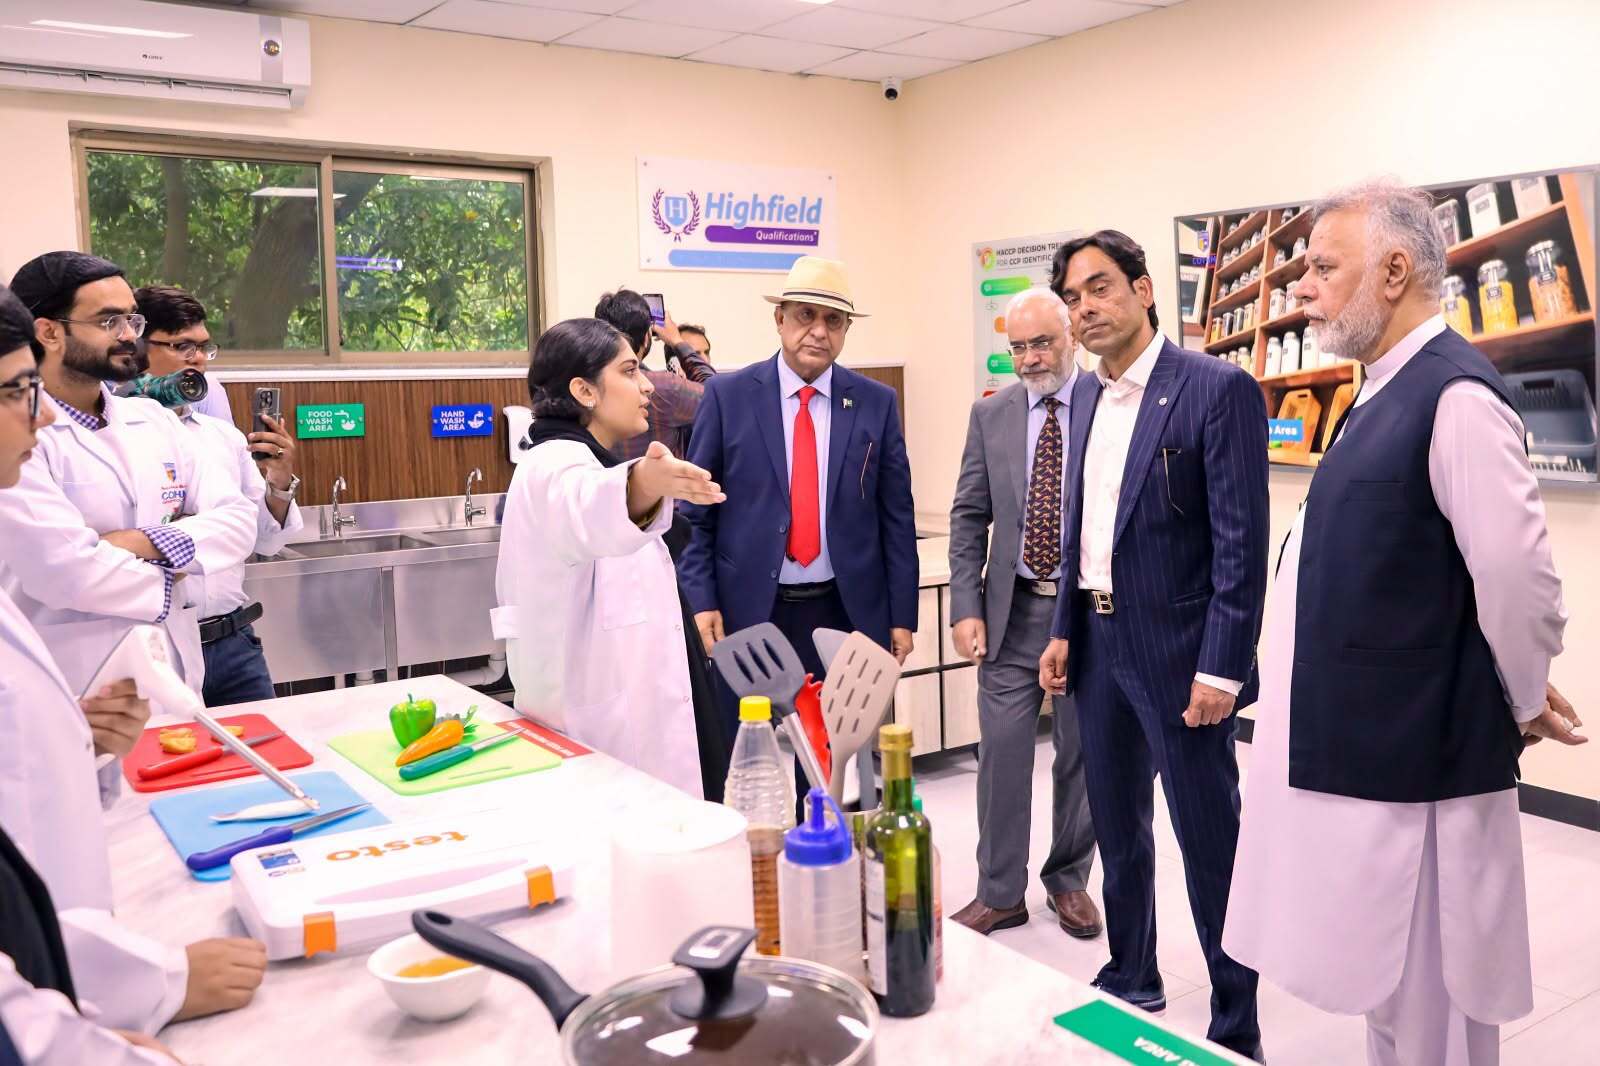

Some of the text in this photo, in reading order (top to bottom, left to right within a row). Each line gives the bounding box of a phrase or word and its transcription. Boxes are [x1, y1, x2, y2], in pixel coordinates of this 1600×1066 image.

[705, 192, 822, 229] Highfield
[755, 230, 814, 242] Qualifications
[997, 248, 1016, 256] HACCP
[1018, 244, 1045, 254] DECISION
[308, 410, 333, 418] FOOD
[441, 410, 465, 418] HAND
[306, 417, 333, 425] WASH
[440, 417, 465, 425] WASH
[308, 424, 333, 432] AREA
[1274, 424, 1297, 435] Area
[326, 831, 468, 861] testo
[1134, 1037, 1181, 1063] AREA
